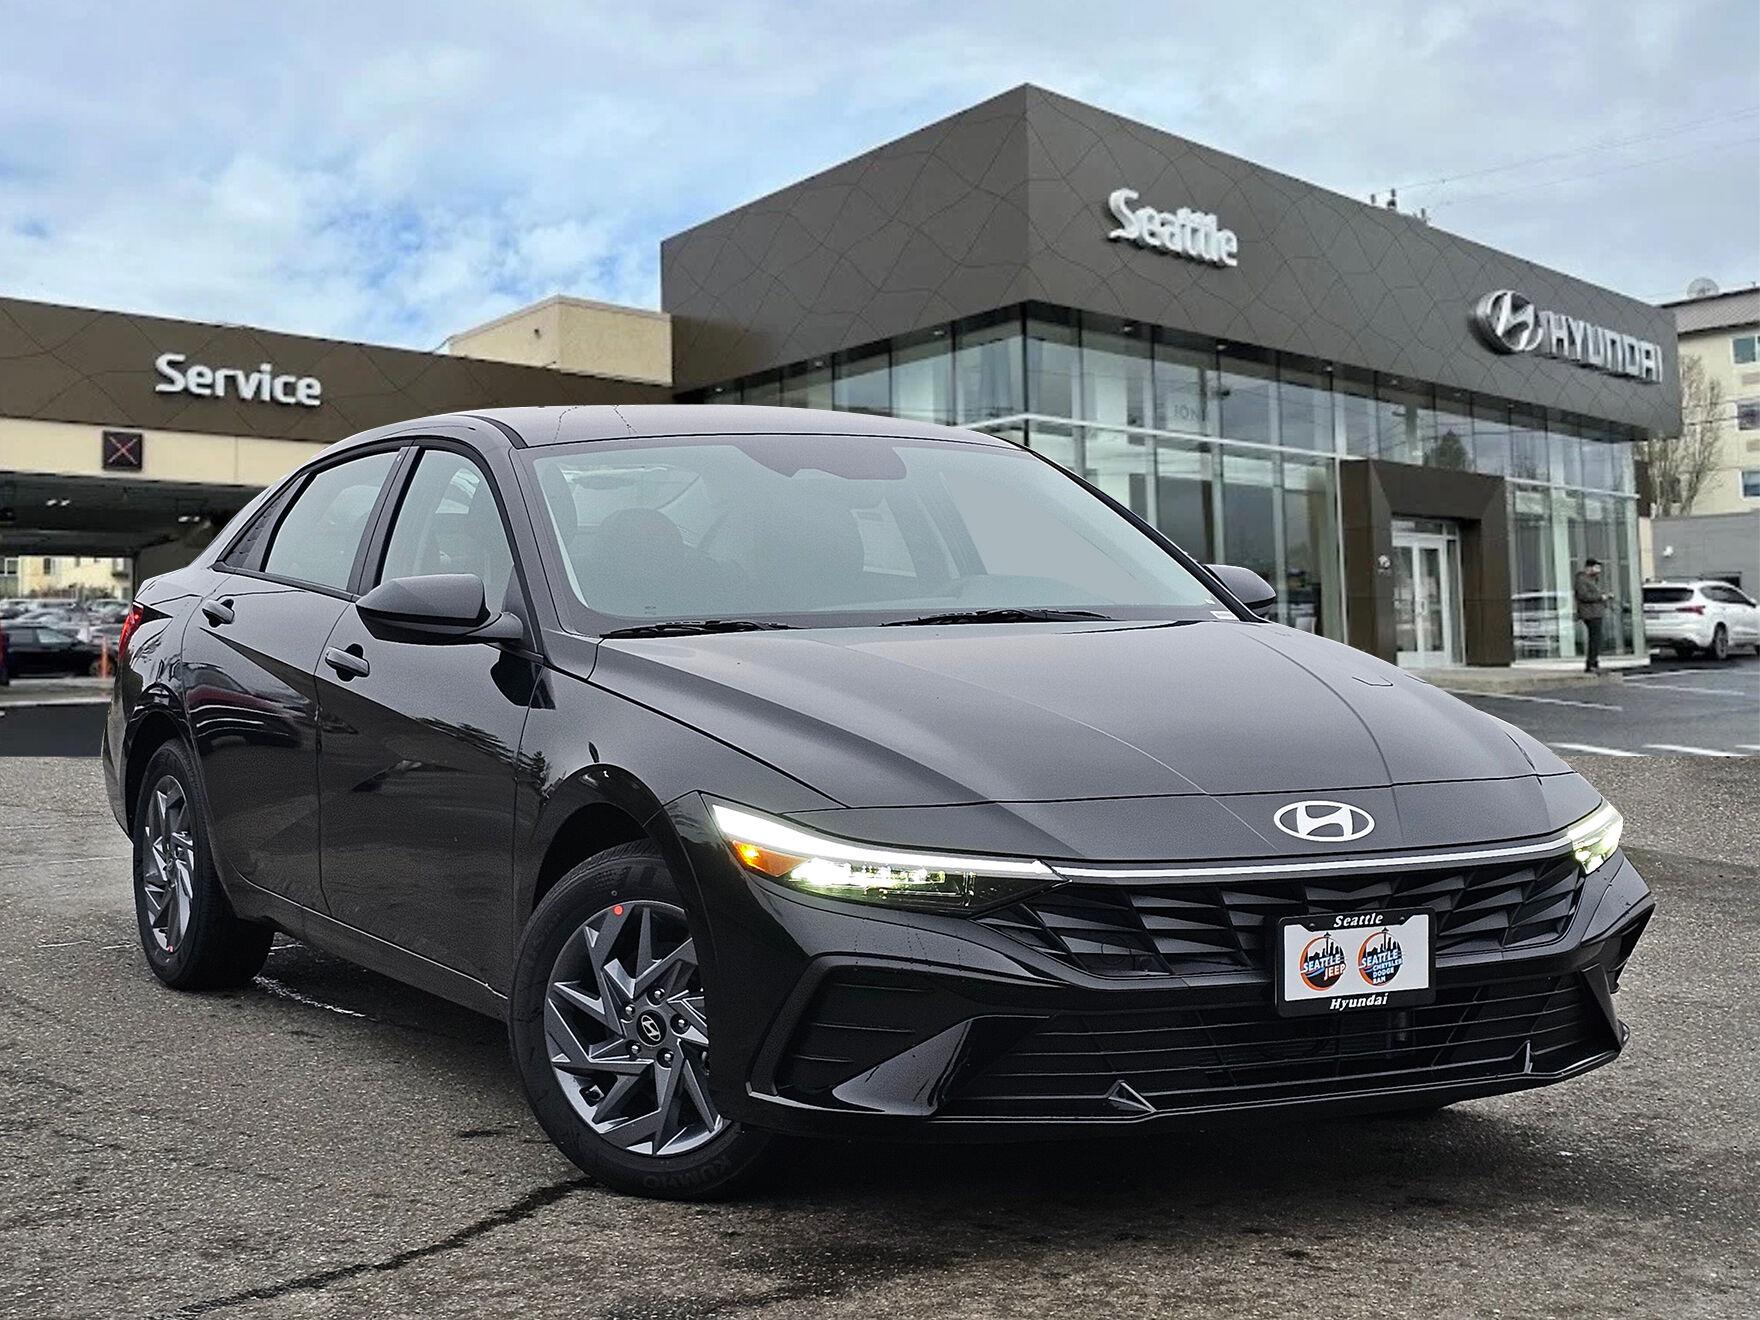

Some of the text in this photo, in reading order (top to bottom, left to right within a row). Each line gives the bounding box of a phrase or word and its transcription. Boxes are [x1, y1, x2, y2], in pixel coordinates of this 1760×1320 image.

[1109, 188, 1238, 266] Seattle
[1543, 311, 1663, 383] HYUNDAI
[155, 353, 322, 406] Service
[1333, 913, 1384, 928] Seattle
[1302, 954, 1342, 973] SEATTLE
[1360, 949, 1400, 968] SEATTLE
[1372, 958, 1403, 971] CHRYSLER
[1324, 963, 1346, 980] JEEP
[1372, 966, 1395, 978] DODGE
[1372, 976, 1386, 985] RAM
[1330, 993, 1389, 1011] Hyundai
[642, 1154, 733, 1190] KUMHO
